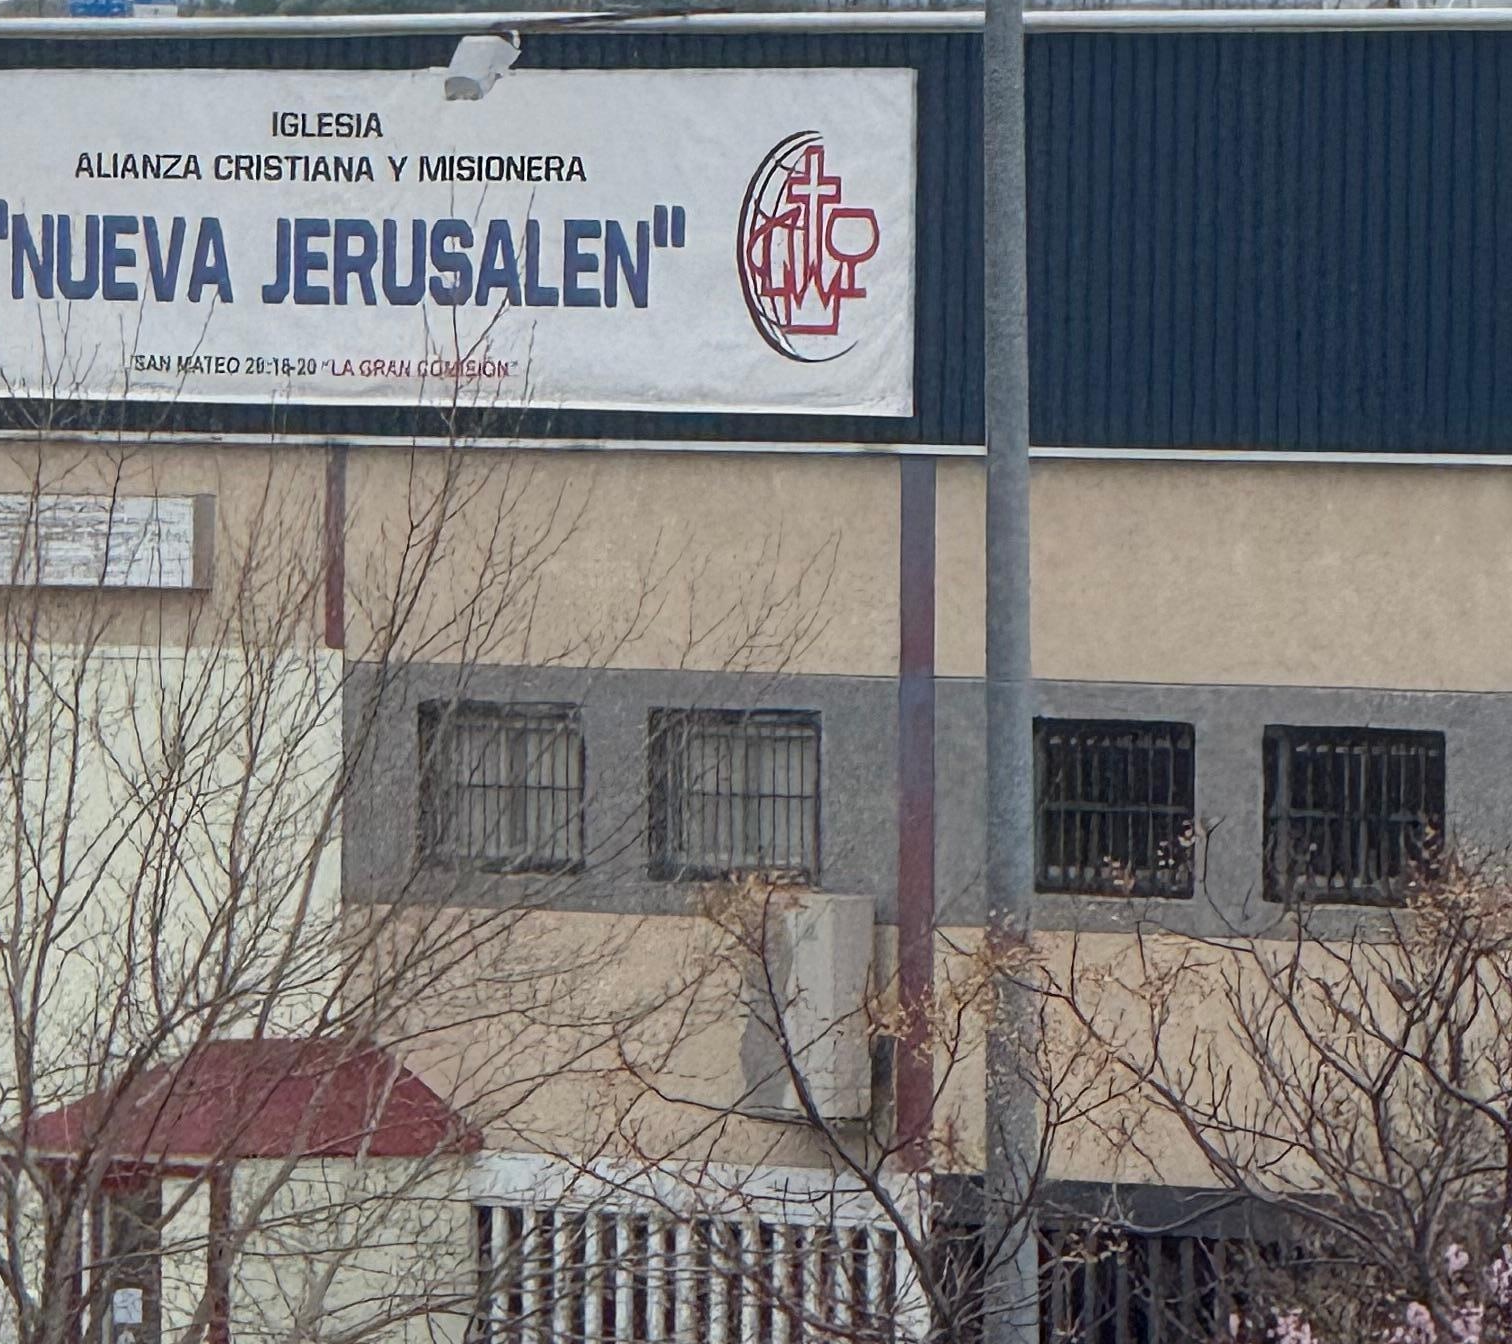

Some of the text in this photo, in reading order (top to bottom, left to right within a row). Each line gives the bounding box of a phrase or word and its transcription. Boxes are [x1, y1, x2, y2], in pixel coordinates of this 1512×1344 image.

[272, 111, 384, 139] IGLESIA
[75, 152, 587, 183] ALIANZA CRISTIANA Y MISIONERA
[261, 204, 686, 309] JERUSALEN"
[134, 355, 171, 374] SAN
[177, 355, 241, 375] MATEO
[360, 358, 411, 378] GRAN
